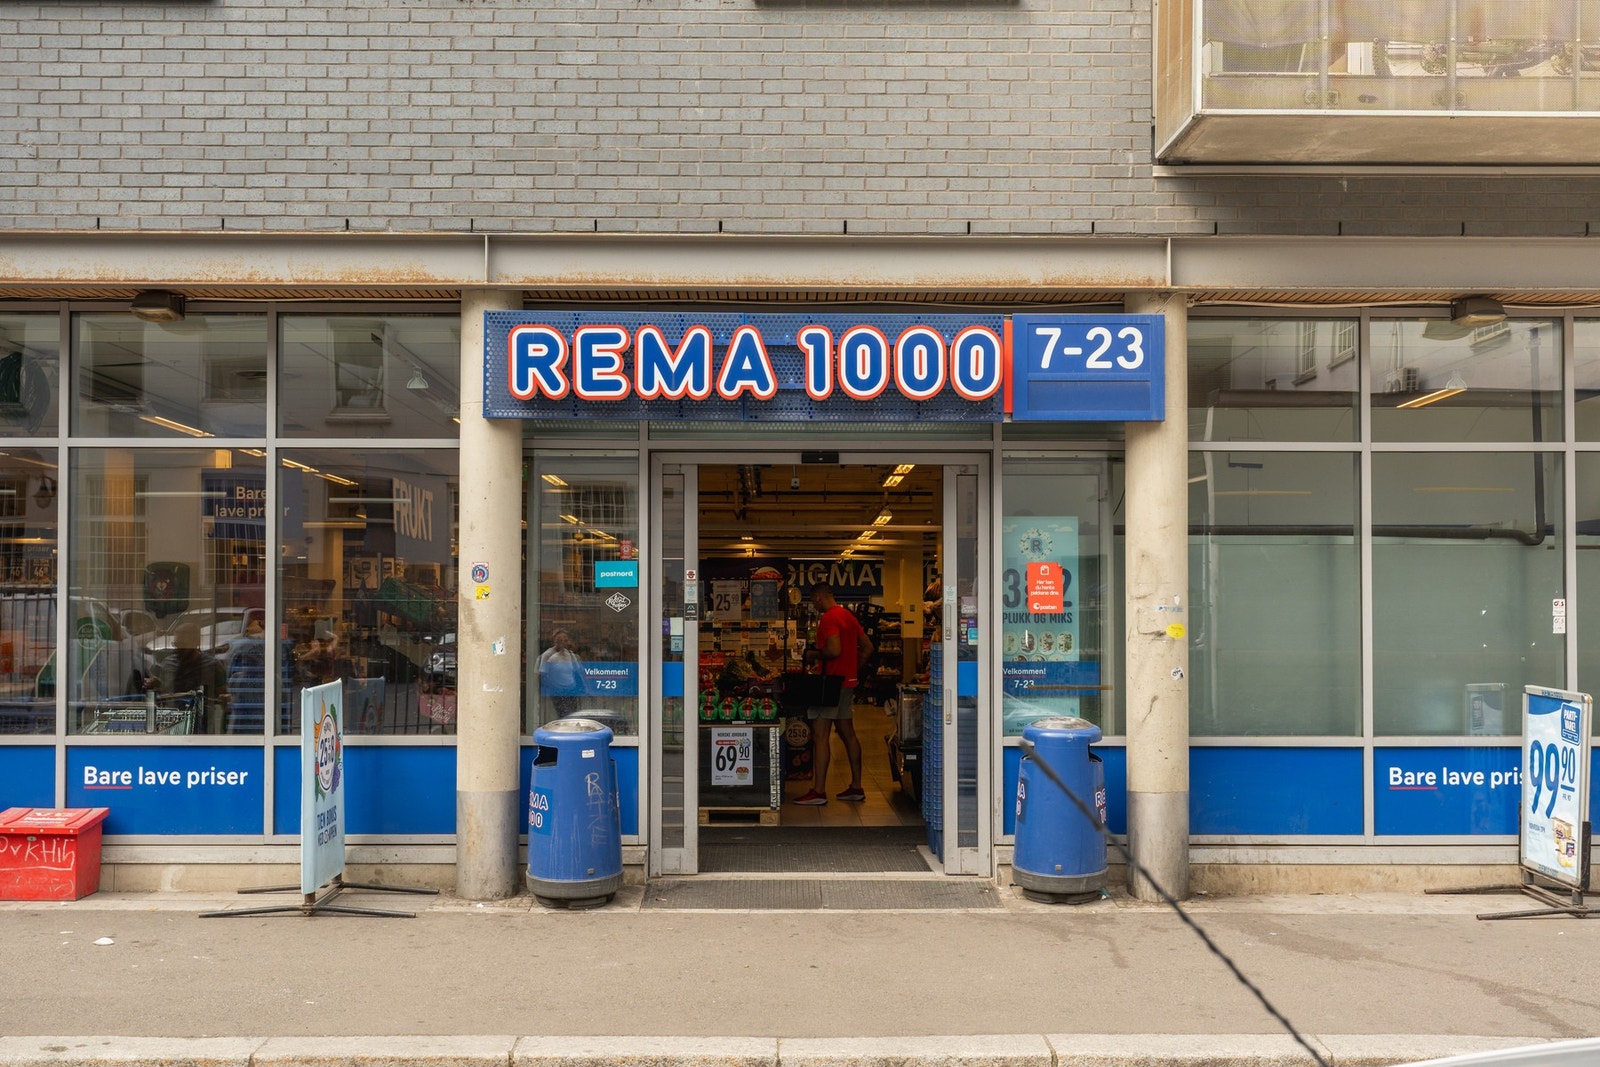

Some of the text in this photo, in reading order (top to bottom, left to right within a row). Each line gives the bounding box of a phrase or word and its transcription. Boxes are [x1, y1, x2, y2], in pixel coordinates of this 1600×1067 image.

[1035, 326, 1145, 370] 7-23
[508, 324, 1004, 401] REMA 1000
[215, 504, 245, 518] lave
[392, 477, 433, 542] FRUKT
[600, 570, 634, 578] postnord
[1003, 612, 1072, 624] PLUKK OG MIKS
[585, 668, 629, 676] Velkommen!
[596, 680, 617, 689] 7-23
[715, 746, 750, 771] 69 90
[84, 766, 248, 789] Bare lave priser
[1389, 767, 1437, 785] Bare
[1443, 767, 1484, 785] lave
[1530, 740, 1576, 819] 99 90
